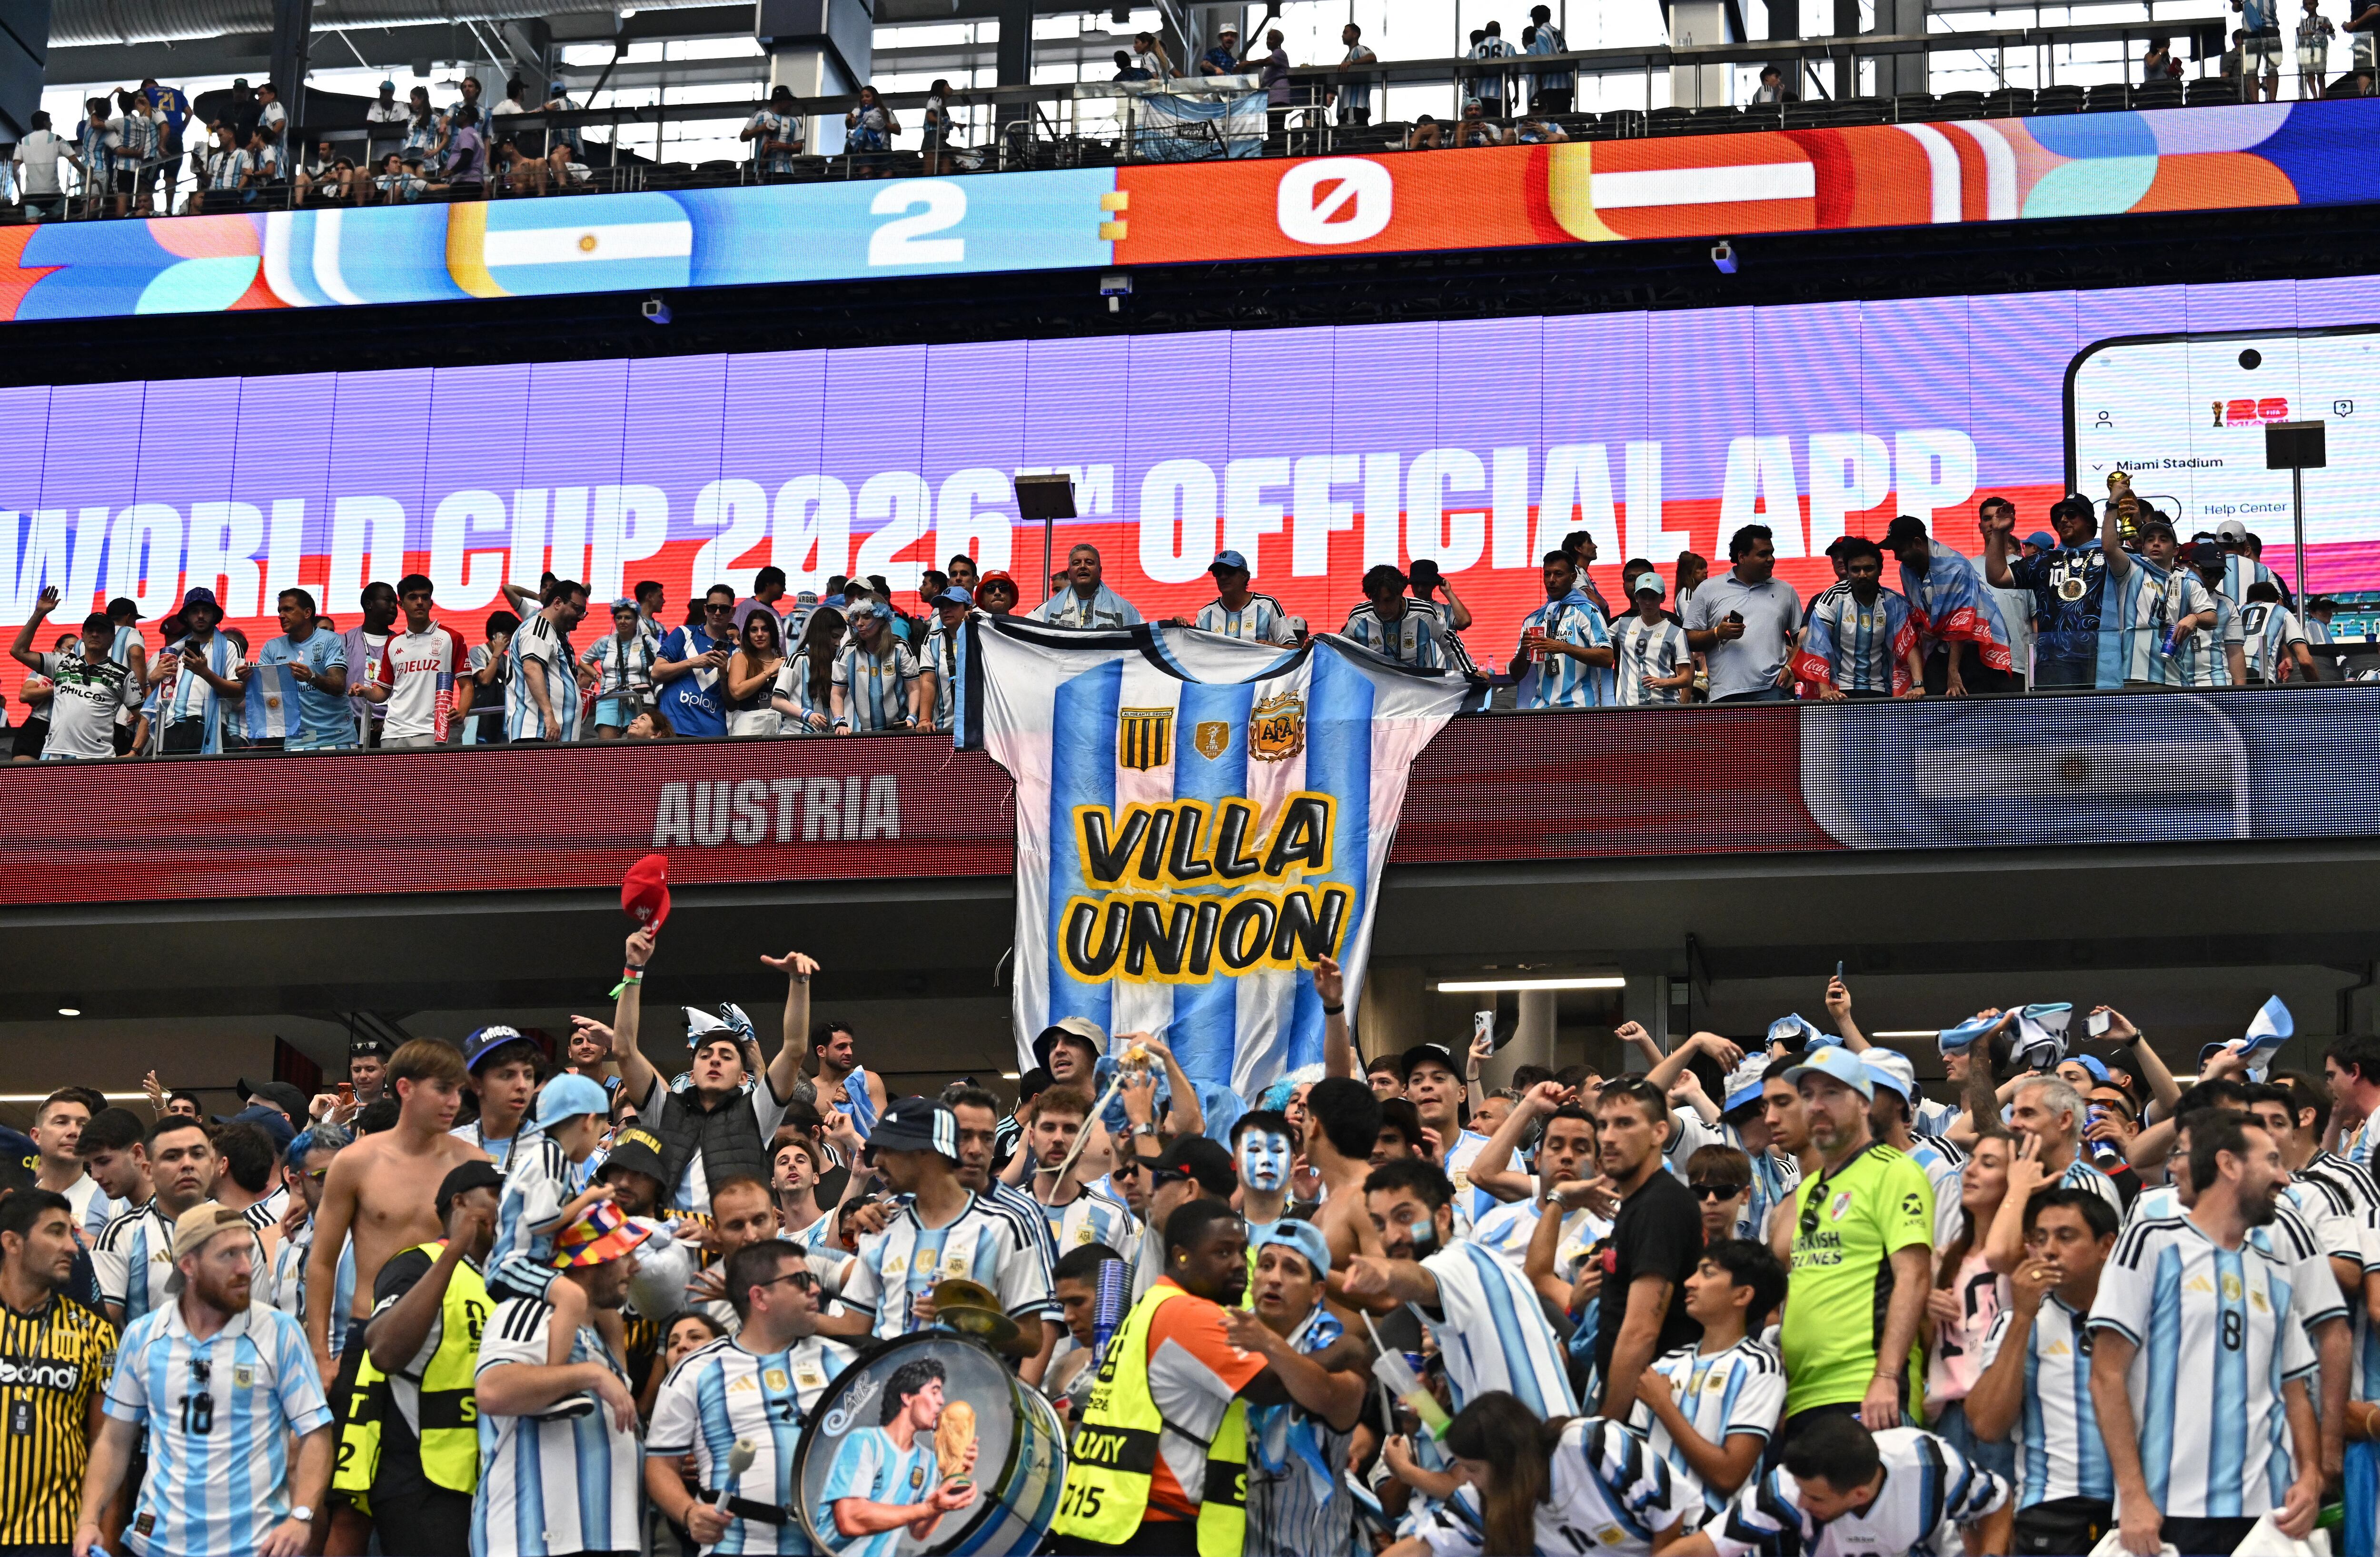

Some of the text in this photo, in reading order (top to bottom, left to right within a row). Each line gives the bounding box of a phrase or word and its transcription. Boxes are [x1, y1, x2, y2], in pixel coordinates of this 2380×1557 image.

[157, 92, 175, 111] 21
[1278, 156, 1393, 245] 0
[869, 180, 967, 267] 2
[2117, 458, 2223, 470] Miami Stadium
[0, 496, 406, 626] WORLD
[429, 485, 669, 611] CUP
[1139, 440, 1690, 584] OFFICIAL
[1715, 429, 1977, 561] APP
[2205, 503, 2287, 517] Help Center
[2050, 569, 2065, 587] 10
[405, 660, 440, 673] JELUZ
[1636, 639, 1647, 656] 9
[1261, 716, 1294, 743] AFA
[652, 775, 901, 848] AUSTRIA
[1083, 798, 1329, 882] VILLA
[1066, 889, 1347, 976] UNION
[2224, 1309, 2241, 1351] 8
[178, 1392, 214, 1435] 10
